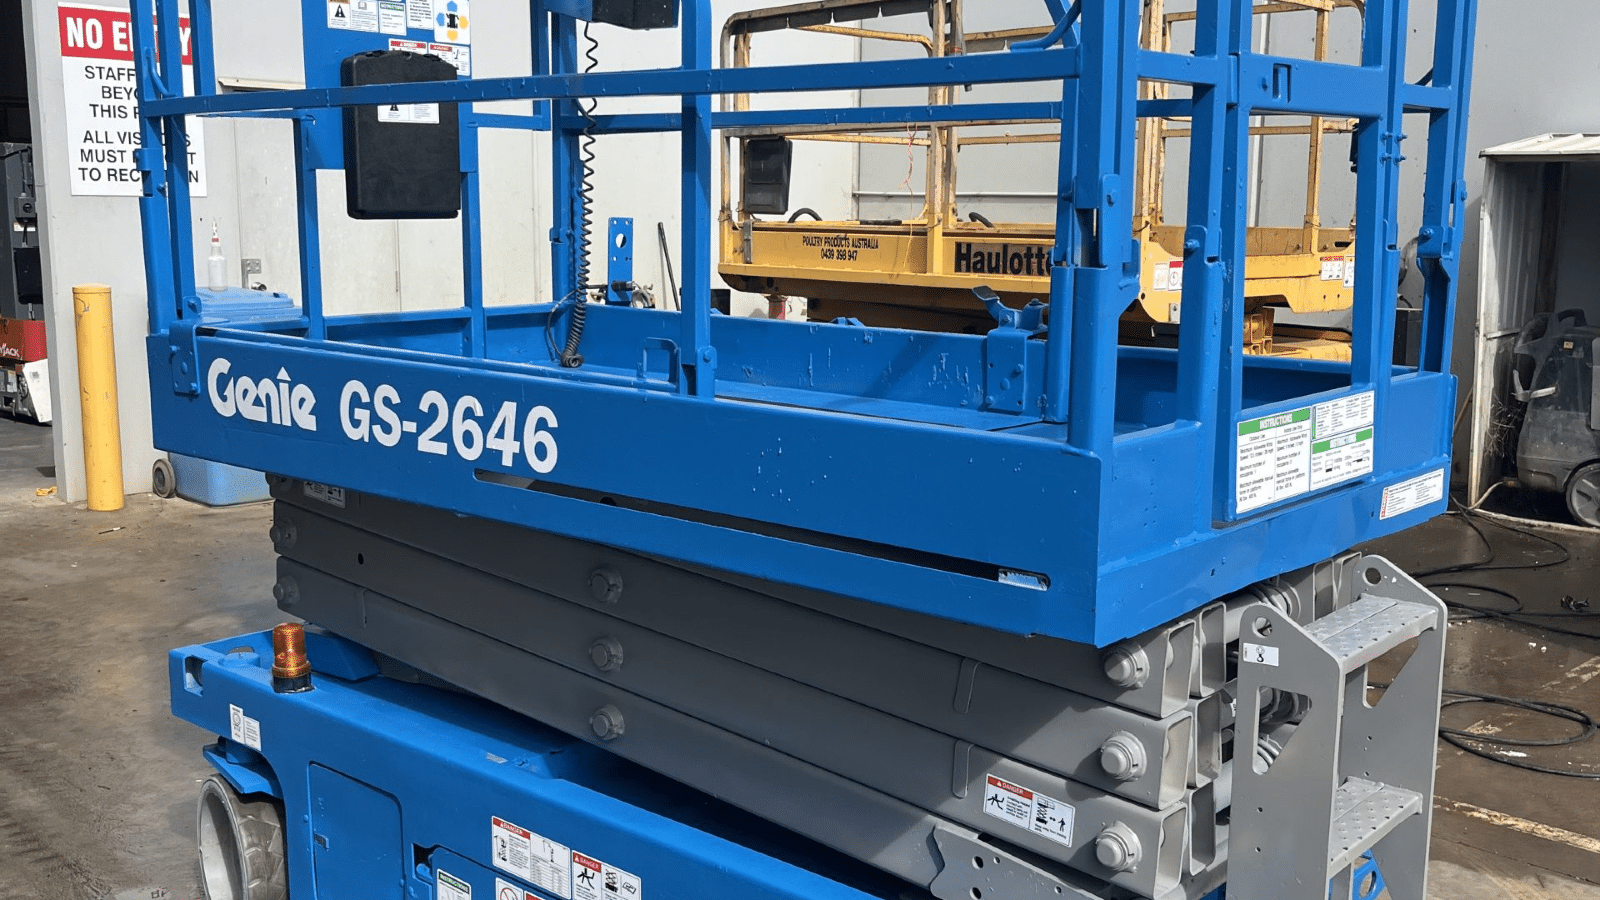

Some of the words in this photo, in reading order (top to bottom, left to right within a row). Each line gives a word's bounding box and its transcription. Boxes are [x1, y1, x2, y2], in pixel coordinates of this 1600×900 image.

[66, 17, 103, 49] NO
[85, 66, 136, 81] STAFF
[101, 86, 139, 100] BEY
[89, 104, 128, 118] THIS
[83, 130, 114, 144] ALL
[117, 131, 190, 147] VISS
[80, 149, 127, 163] MUST
[78, 168, 101, 182] TO
[802, 235, 823, 247] POULTRY
[824, 235, 850, 248] PRODUCTS
[851, 238, 879, 250] AUSTRALIA
[821, 248, 834, 260] 0439
[847, 250, 858, 261] 947
[207, 357, 317, 431] Genie
[340, 380, 558, 473] GS-2646
[1002, 782, 1024, 795] DANGER
[580, 857, 599, 869] DANGER
